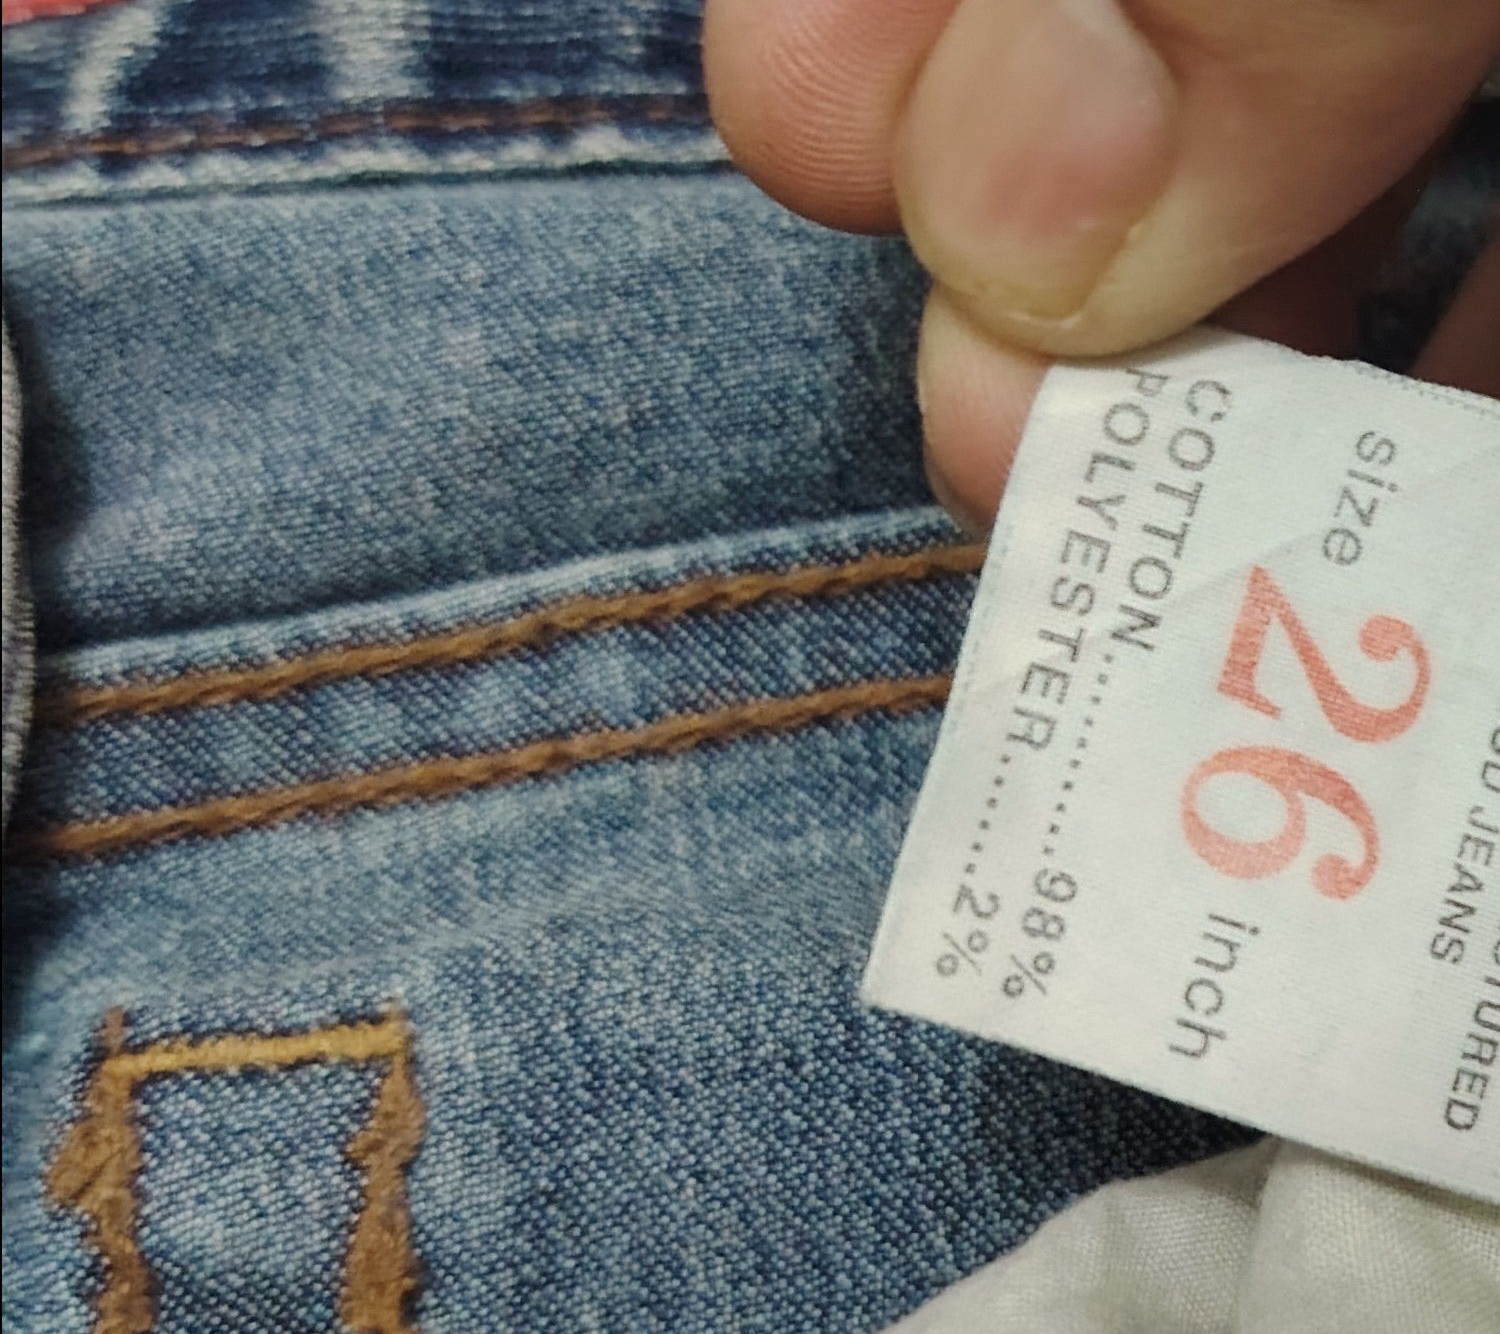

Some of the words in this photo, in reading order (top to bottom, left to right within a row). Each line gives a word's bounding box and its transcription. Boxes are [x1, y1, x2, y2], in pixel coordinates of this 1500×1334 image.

[1322, 430, 1399, 566] size
[1180, 565, 1431, 902] 26
[1429, 805, 1500, 965] JEANS
[1168, 913, 1261, 1060] inch
